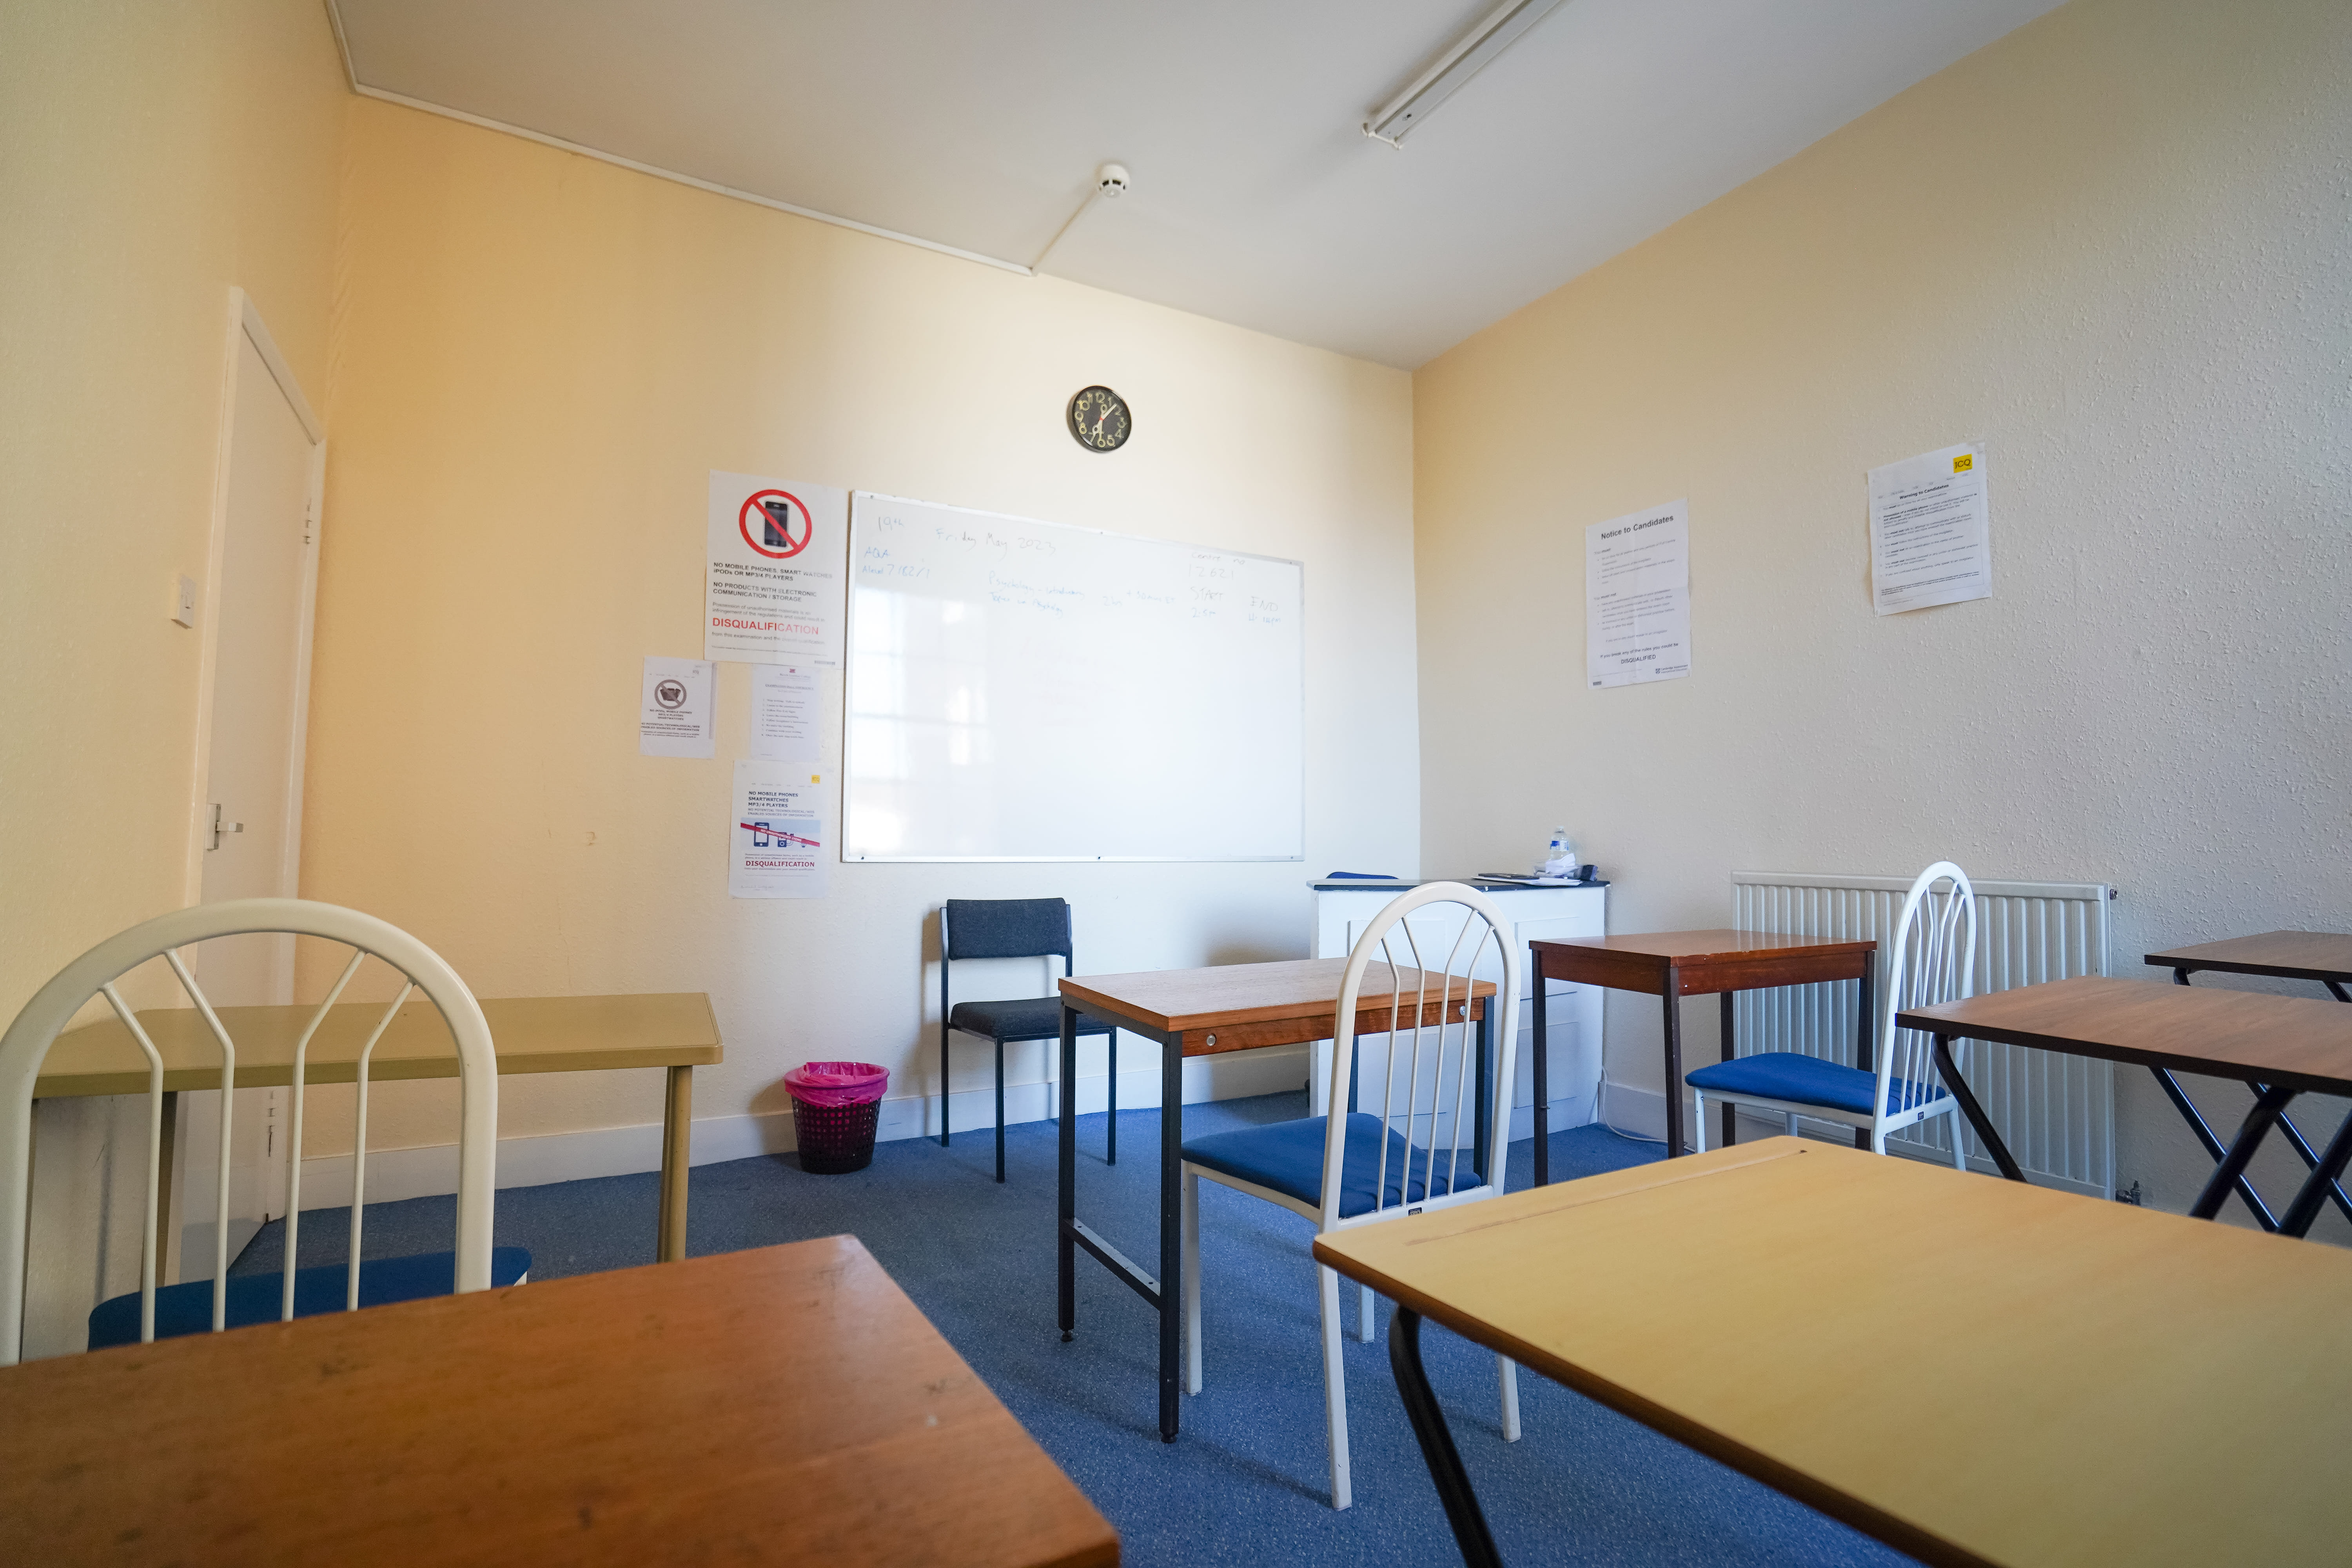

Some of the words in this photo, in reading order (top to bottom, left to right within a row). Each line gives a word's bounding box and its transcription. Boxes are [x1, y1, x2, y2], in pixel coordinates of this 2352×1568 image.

[1096, 392, 1105, 404] 12
[1108, 396, 1112, 406] 1
[1077, 399, 1090, 411] 10
[1114, 405, 1123, 416] 2
[1074, 411, 1084, 423] 9
[1117, 417, 1127, 428] 3
[1079, 422, 1087, 434] 8
[1114, 428, 1124, 439] 4
[1106, 434, 1116, 446] 5
[1955, 459, 1971, 469] JCQ
[1924, 485, 1949, 494] Candidates
[1601, 529, 1622, 540] Notice
[1633, 515, 1674, 531] Candidates
[864, 546, 890, 559] AQA
[986, 532, 1007, 563] May
[1018, 537, 1057, 556] 2023
[1189, 563, 1234, 581] 12621
[713, 588, 768, 599] COMMUNICATION
[724, 583, 759, 592] PRODUCTS
[778, 588, 817, 597] ELECTRONIC
[1191, 586, 1224, 602] START
[1250, 596, 1279, 612] END
[712, 617, 819, 635] DISQUALIFICATION
[1621, 654, 1657, 664] DISQUALIFIED
